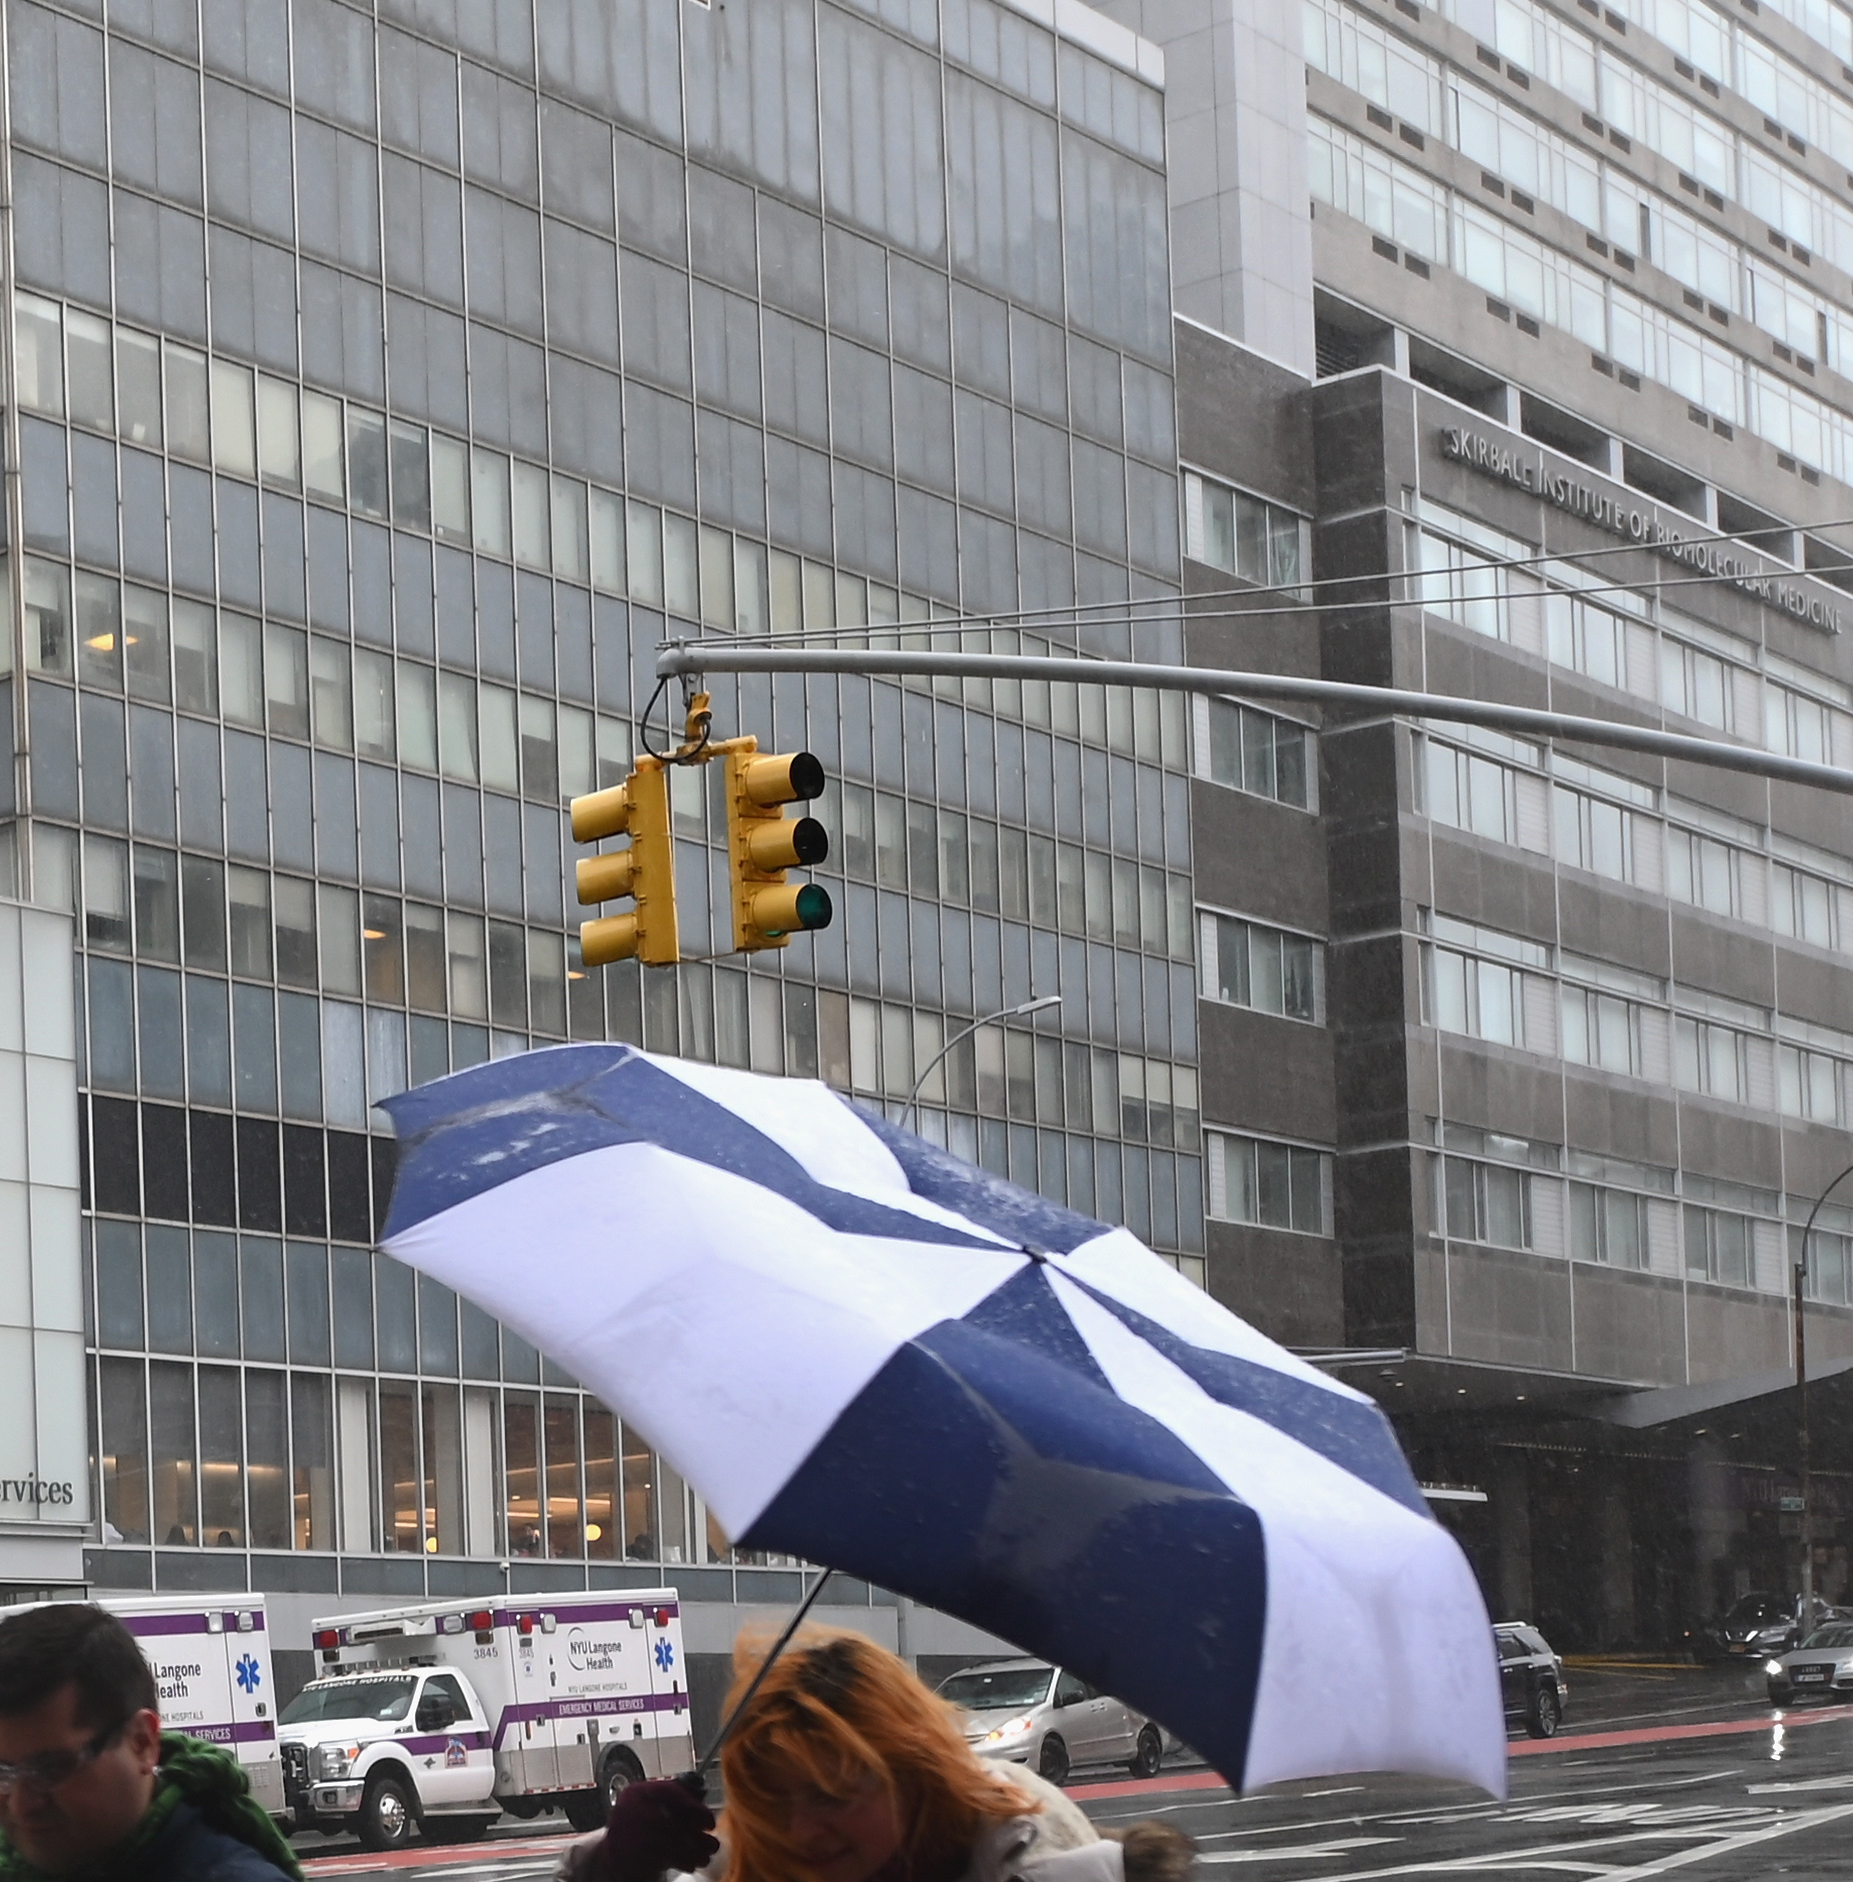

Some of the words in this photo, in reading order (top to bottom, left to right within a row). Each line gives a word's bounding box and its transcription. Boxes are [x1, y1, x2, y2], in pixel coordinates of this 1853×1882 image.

[1450, 428, 1531, 487] SKIRBALL
[1538, 464, 1624, 529] INSTITUTE
[1630, 510, 1650, 541] OF
[1778, 580, 1842, 634] MEDICINE
[474, 1647, 499, 1660] 3845
[570, 1641, 587, 1655] NYU
[588, 1641, 622, 1658] Langone
[154, 1662, 201, 1681] Langone
[586, 1657, 613, 1671] Health
